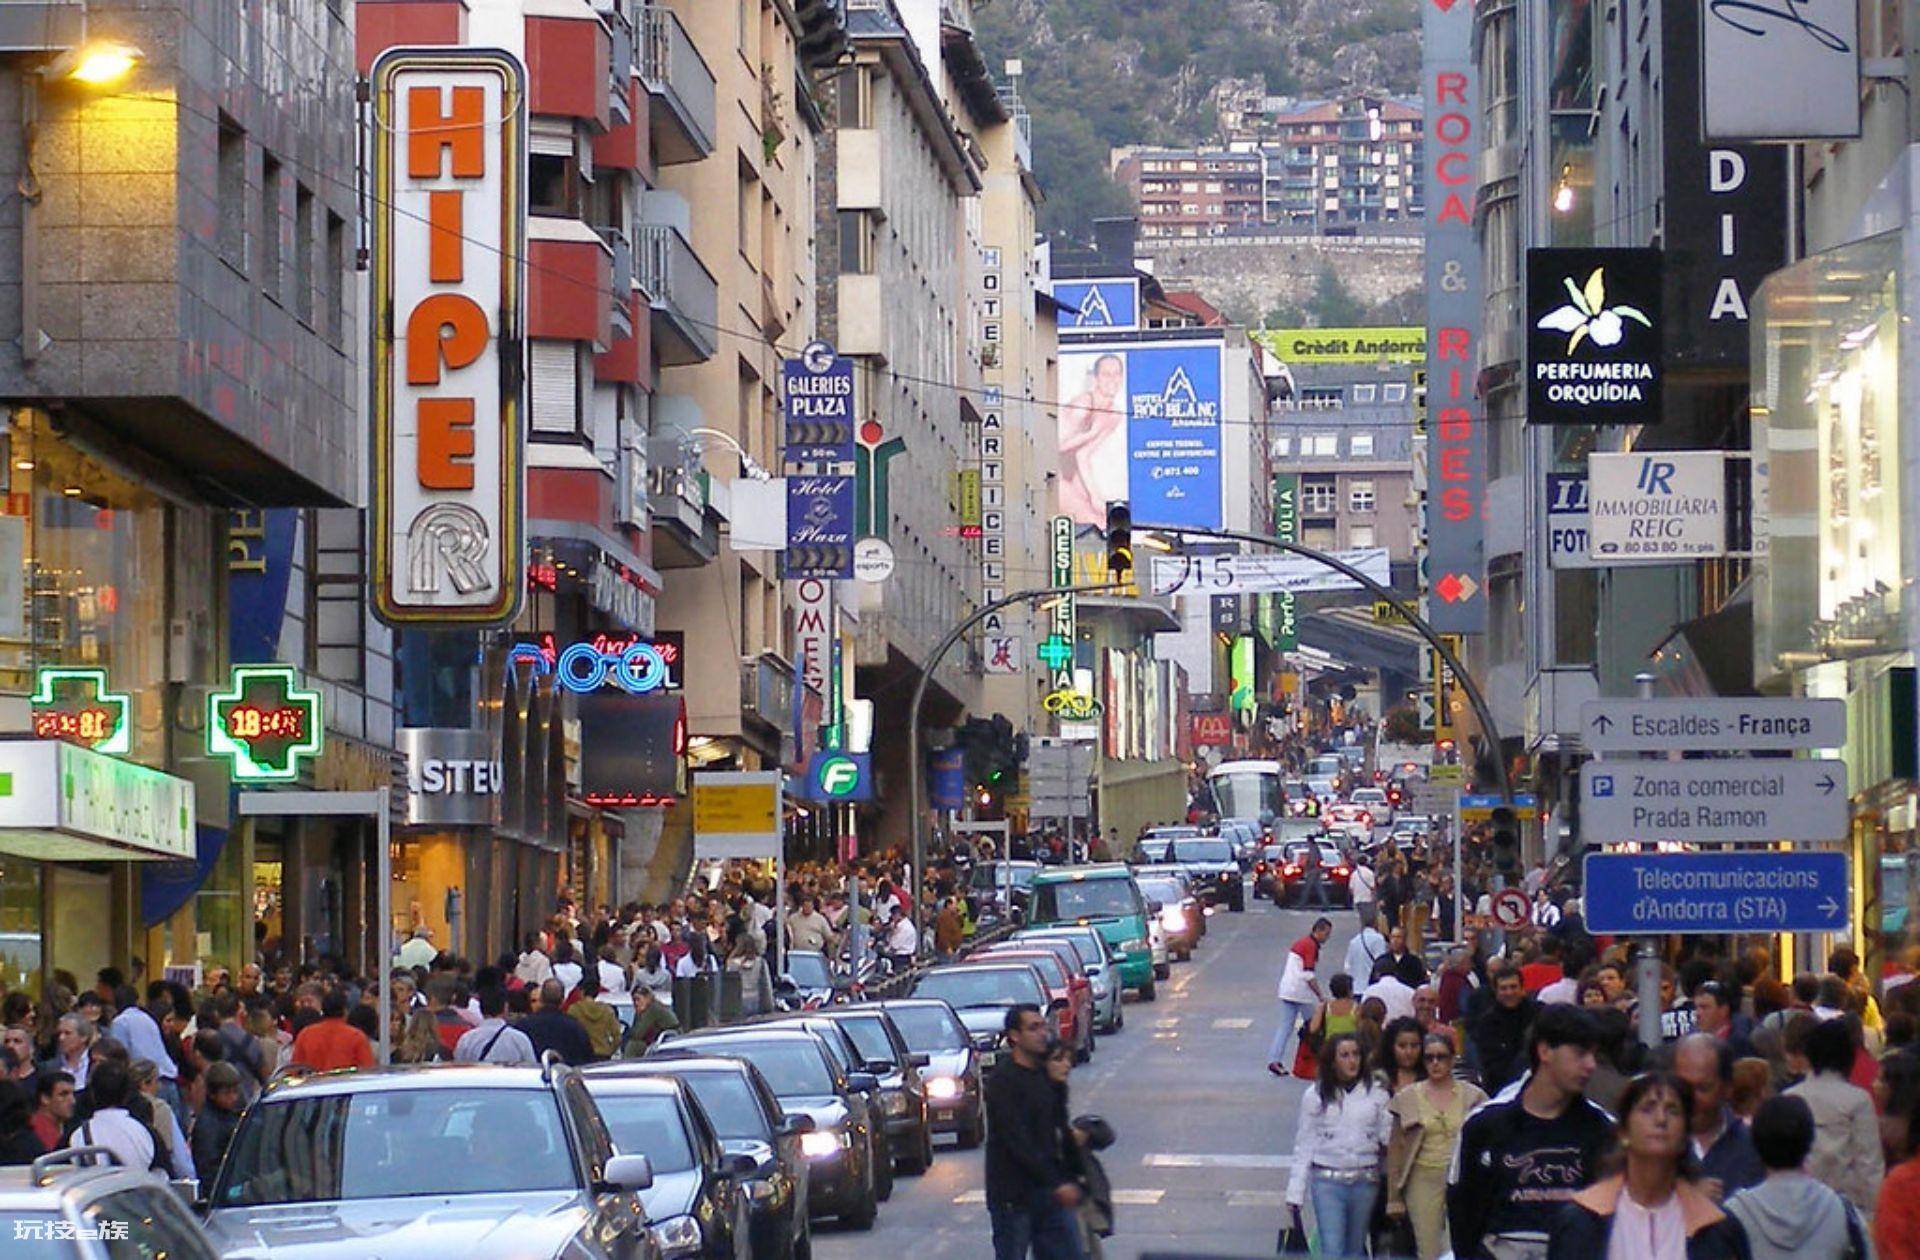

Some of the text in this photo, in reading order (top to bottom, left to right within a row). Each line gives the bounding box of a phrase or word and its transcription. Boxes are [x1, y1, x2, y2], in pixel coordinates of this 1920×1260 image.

[1436, 73, 1472, 224] ROCA
[1440, 261, 1468, 292] &
[983, 250, 999, 364] HOTE
[407, 85, 490, 595] HIPER
[1293, 338, 1349, 354] Crèdit
[1536, 363, 1653, 381] PERFUMERIA
[787, 376, 851, 396] GALERIES
[1547, 381, 1642, 404] ORQUÍDIA
[791, 397, 847, 417] PLAZA
[1166, 402, 1217, 417] BLANC
[1438, 328, 1477, 521] RIBES
[791, 479, 847, 496] Hotel
[1637, 457, 1676, 495] IR
[982, 387, 1002, 631] MARTICELLA
[790, 524, 849, 544] Plaza
[1629, 517, 1686, 539] REIG
[1552, 529, 1592, 553] FOT
[1056, 518, 1072, 688] RESIENIA
[1632, 716, 1720, 736] Escaldes
[1739, 715, 1811, 740] França
[1633, 774, 1784, 798] Zona comercial
[1633, 808, 1767, 828] Prada Ramon
[1634, 867, 1819, 889] Telecomunicacions
[1633, 897, 1787, 922] d'Andorra (STA)
